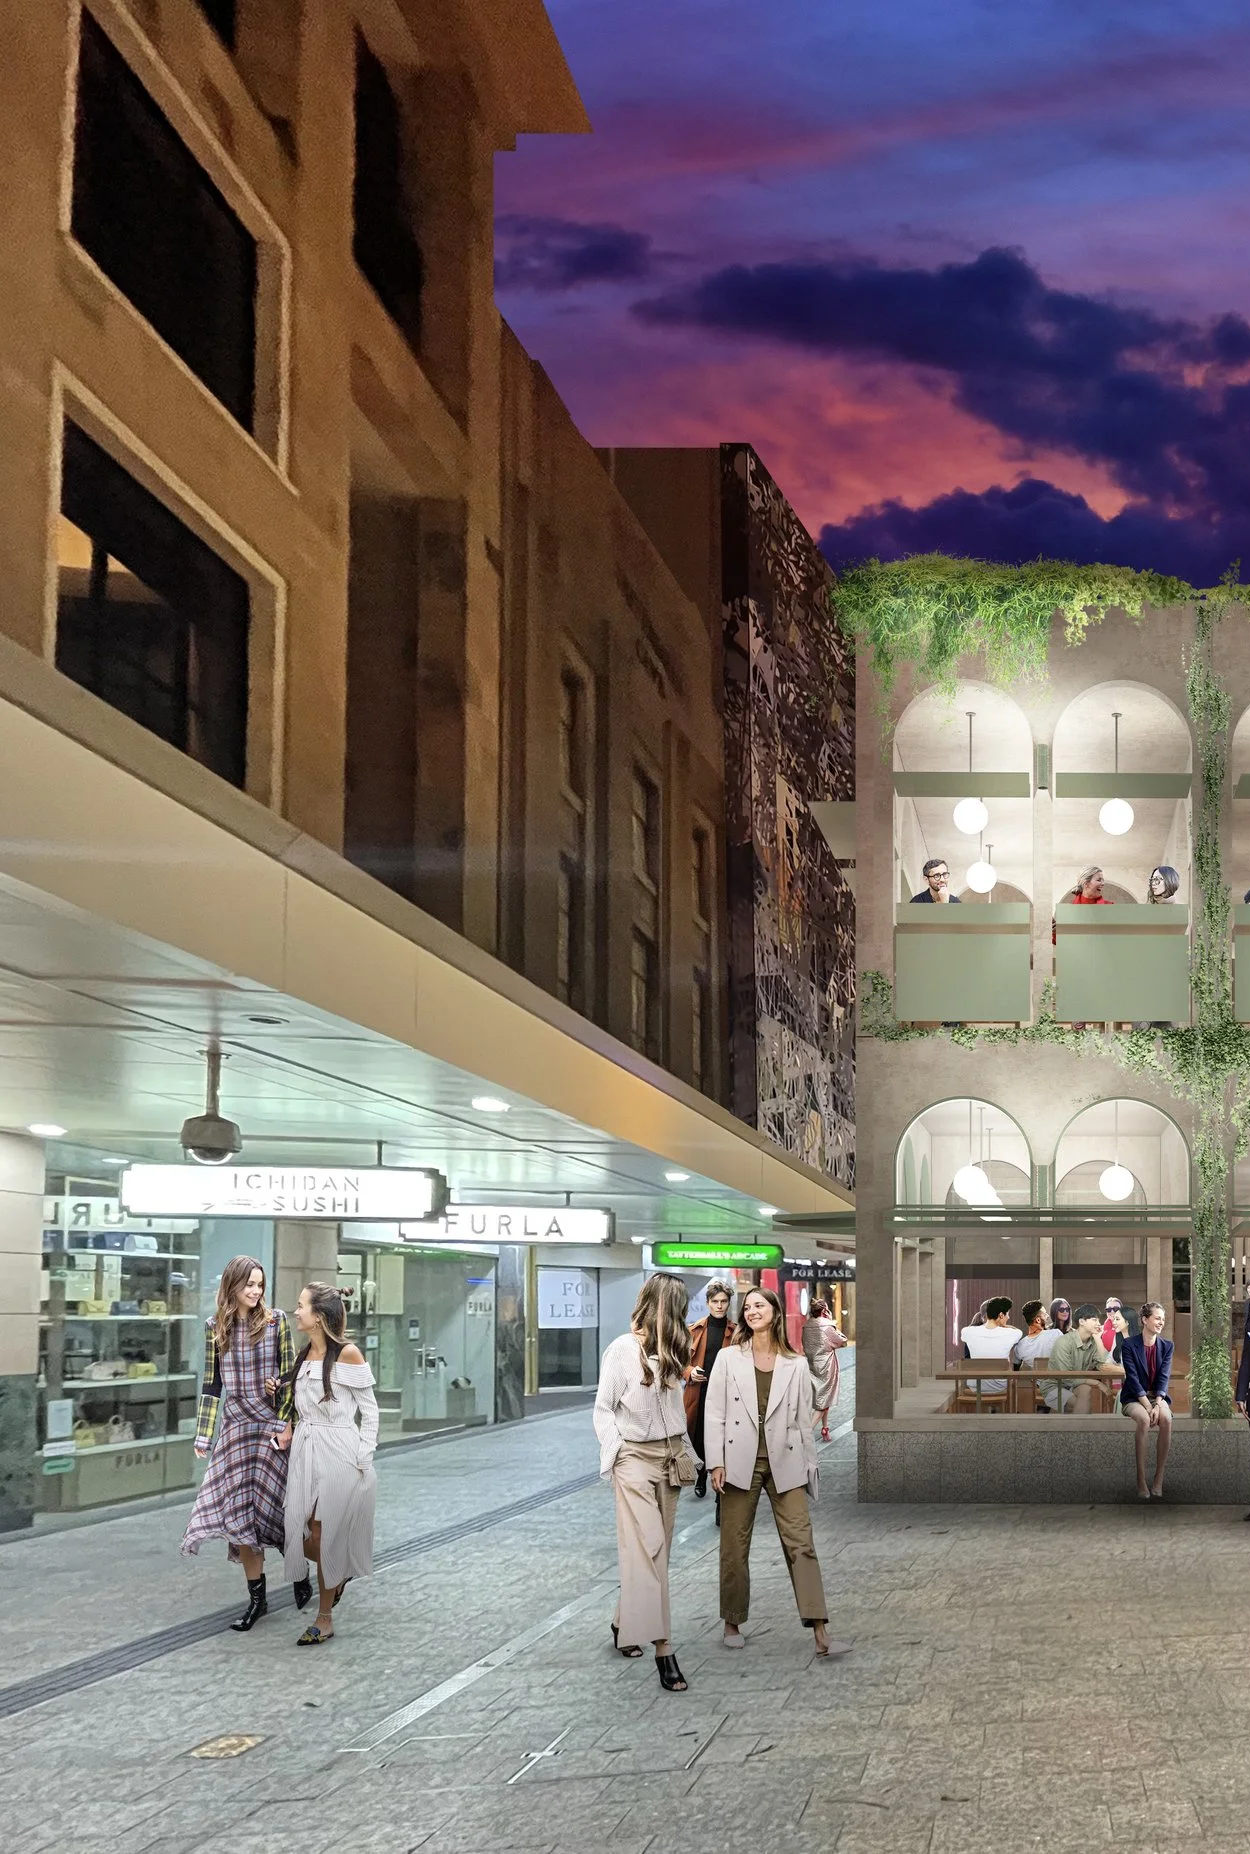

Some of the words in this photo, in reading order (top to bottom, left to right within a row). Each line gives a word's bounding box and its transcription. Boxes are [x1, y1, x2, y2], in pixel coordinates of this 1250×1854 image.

[233, 1173, 360, 1192] ICHIBAN
[272, 1196, 360, 1214] SUSHI
[444, 1213, 564, 1237] FURLA
[791, 1268, 814, 1278] FOR
[817, 1268, 853, 1278] LEASE
